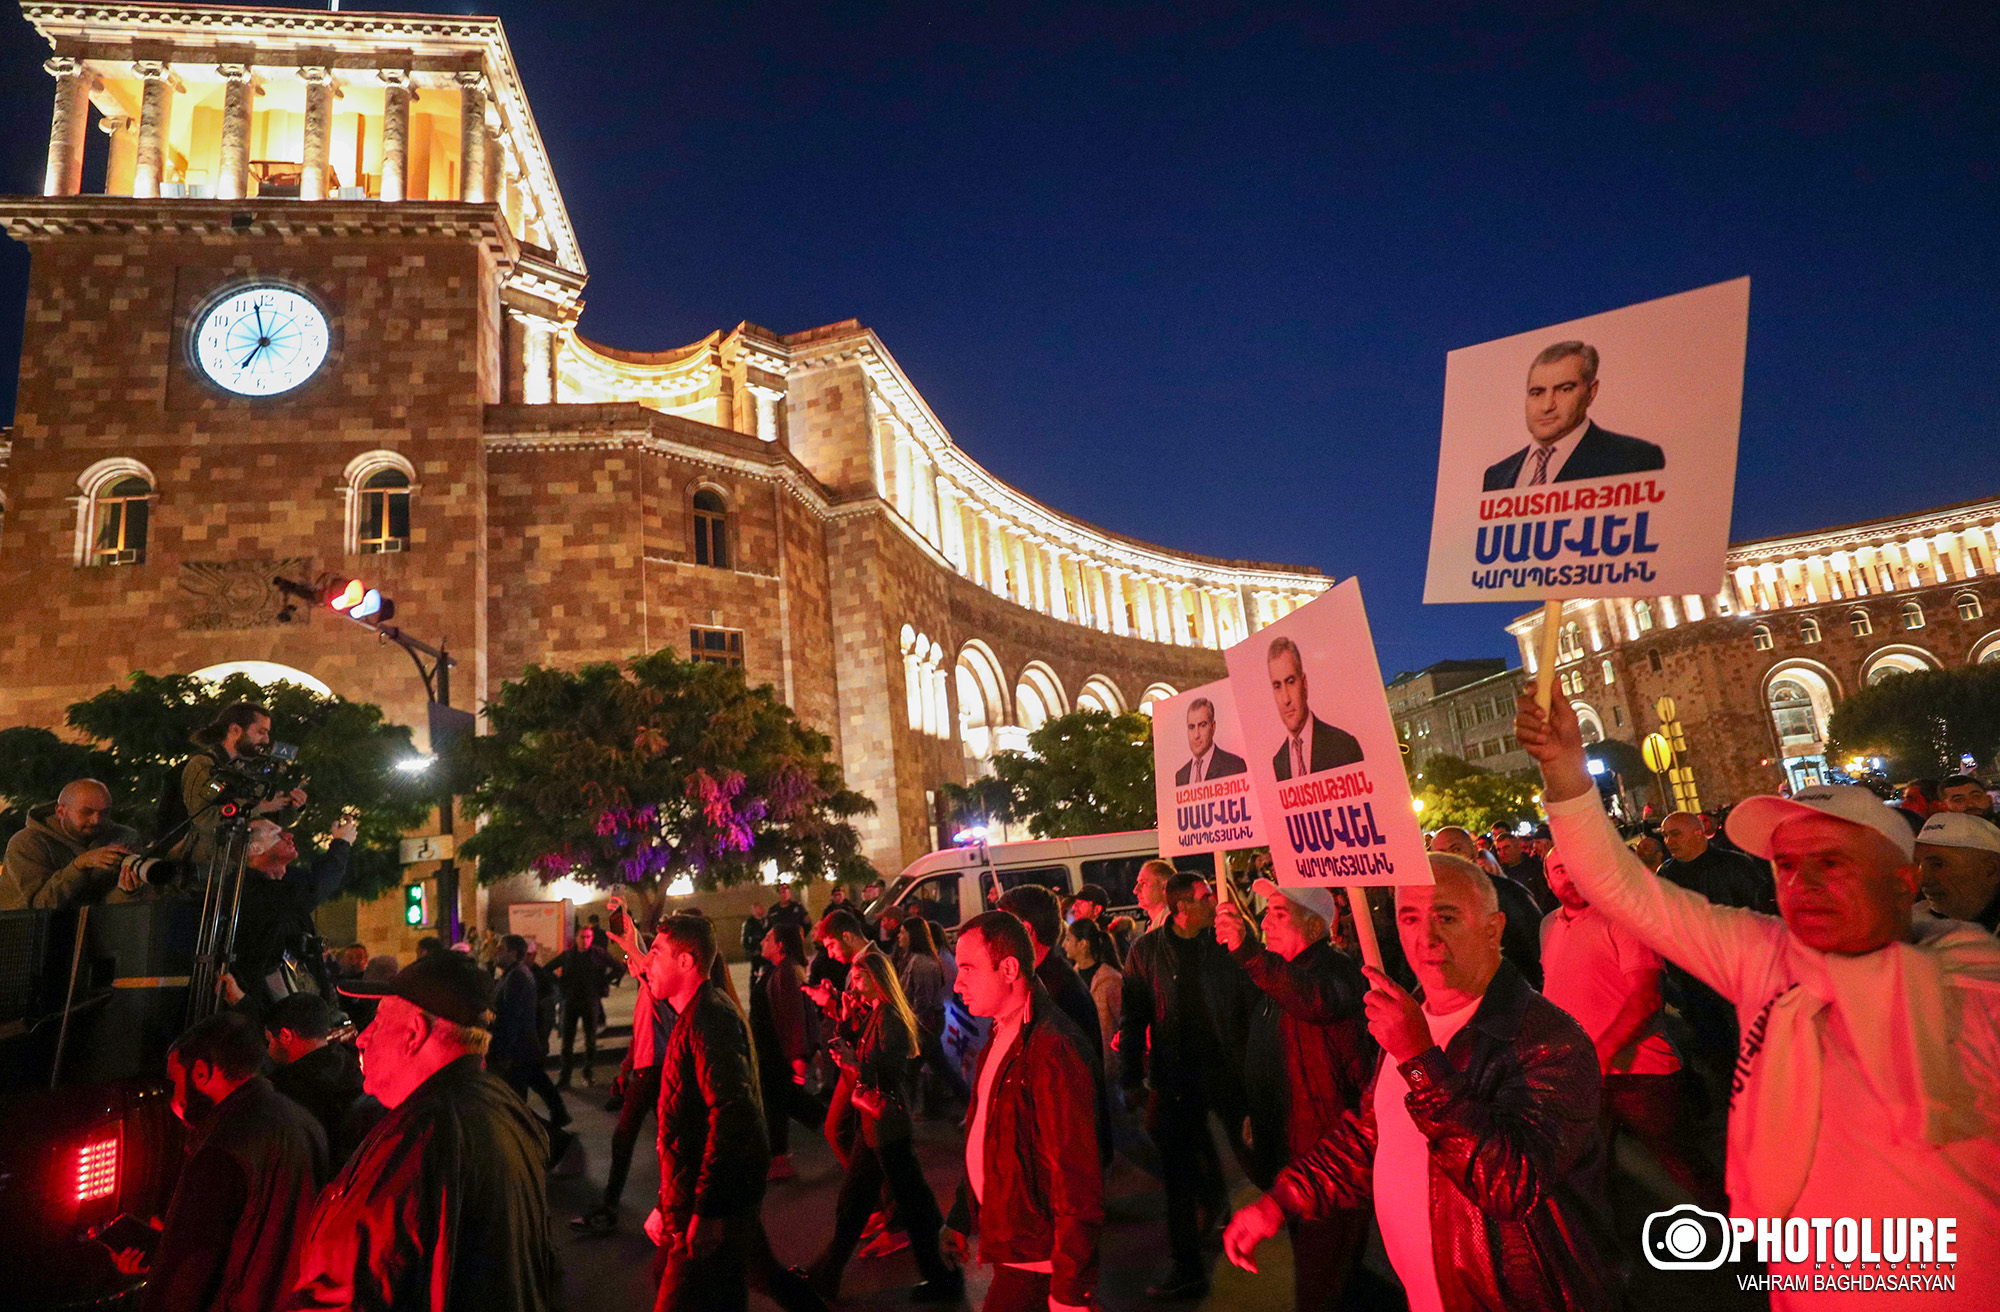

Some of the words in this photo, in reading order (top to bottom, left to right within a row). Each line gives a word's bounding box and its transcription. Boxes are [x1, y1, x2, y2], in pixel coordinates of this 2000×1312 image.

[235, 300, 247, 312] 11
[289, 300, 294, 312] 1
[214, 315, 229, 327] 10
[1479, 480, 1666, 521] ԱԶԱՏՈՒԹՅՈՒՆ
[1475, 511, 1659, 565] ՍԱՄՎԵԼ
[1471, 560, 1656, 589] ԿԱՐԱՊԵՏՅԱՆԻՆ
[1176, 778, 1250, 804] ԱԶԱՏՈՒԹՅՈՒՆ
[1279, 770, 1374, 810] ԱԶԱՏՈՒԹՅՈՒՆ
[1177, 797, 1252, 831] ՍԱՄՎԵԼ
[1178, 826, 1253, 847] ԿԱՐԱՊԵՏՅԱՆԻՆ
[1285, 802, 1387, 854] ՍԱՄՎԵԼ
[1295, 852, 1394, 878] ԿԱՐԱՊԵՏՅԱՆԻՆ
